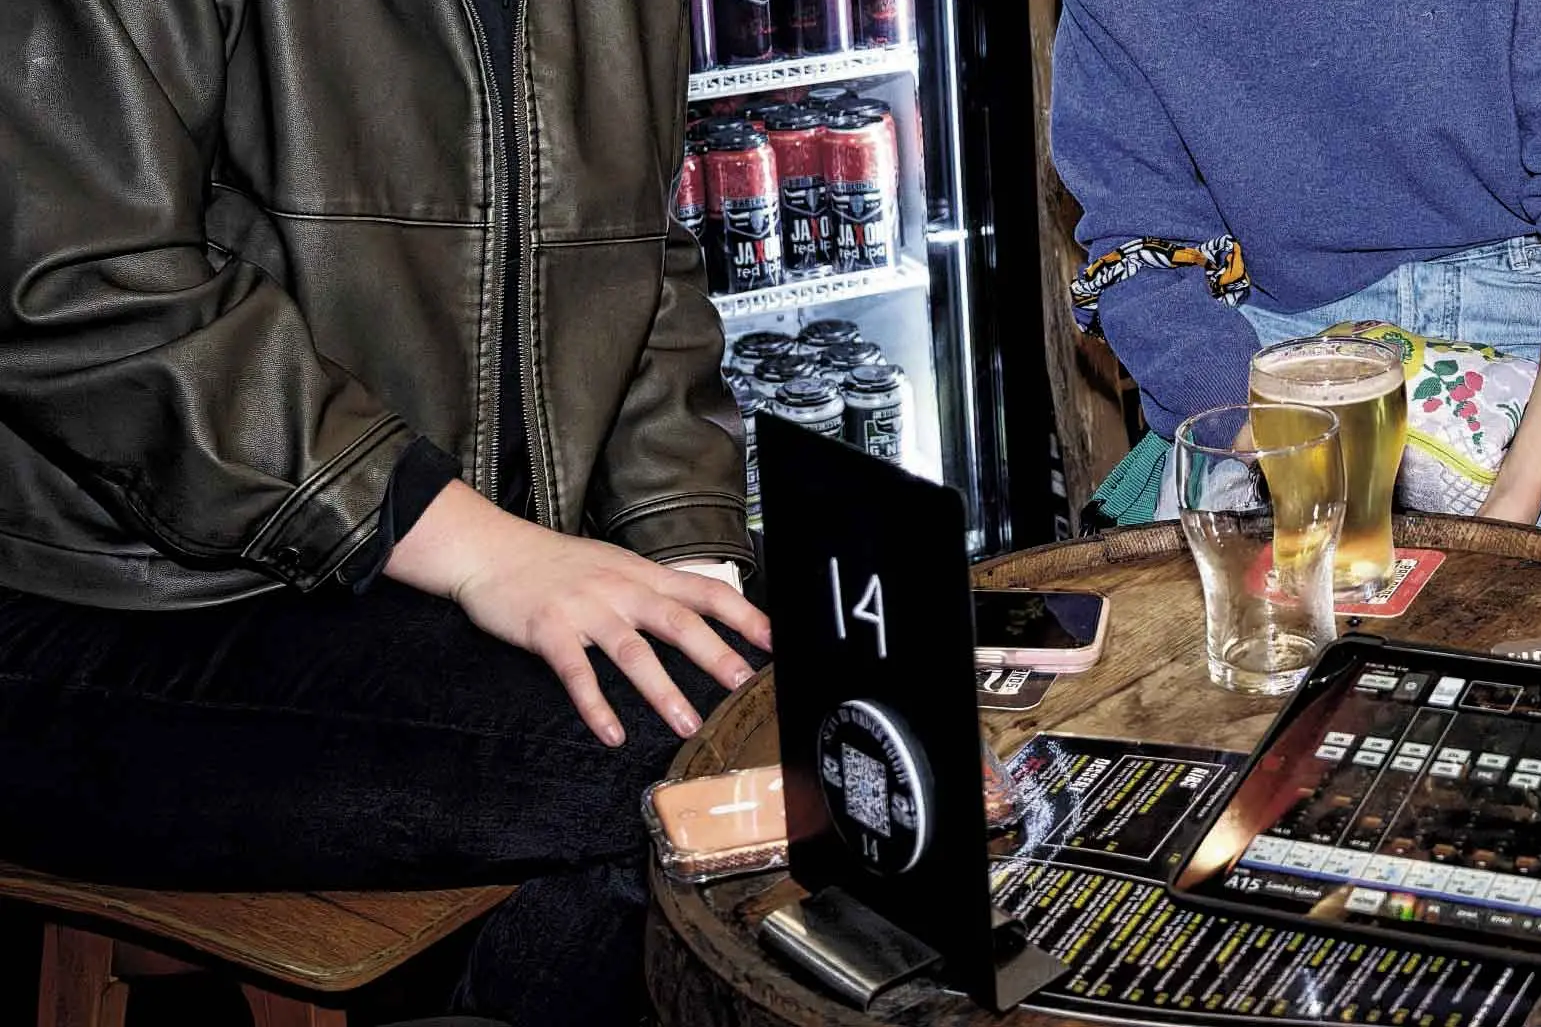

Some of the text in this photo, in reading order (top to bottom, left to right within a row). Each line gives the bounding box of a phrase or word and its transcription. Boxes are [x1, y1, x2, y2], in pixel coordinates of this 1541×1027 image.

[791, 216, 830, 243] JAXO
[793, 242, 816, 255] red
[839, 246, 860, 260] red
[736, 263, 761, 279] red
[829, 557, 887, 658] 14
[1224, 874, 1260, 891] A15
